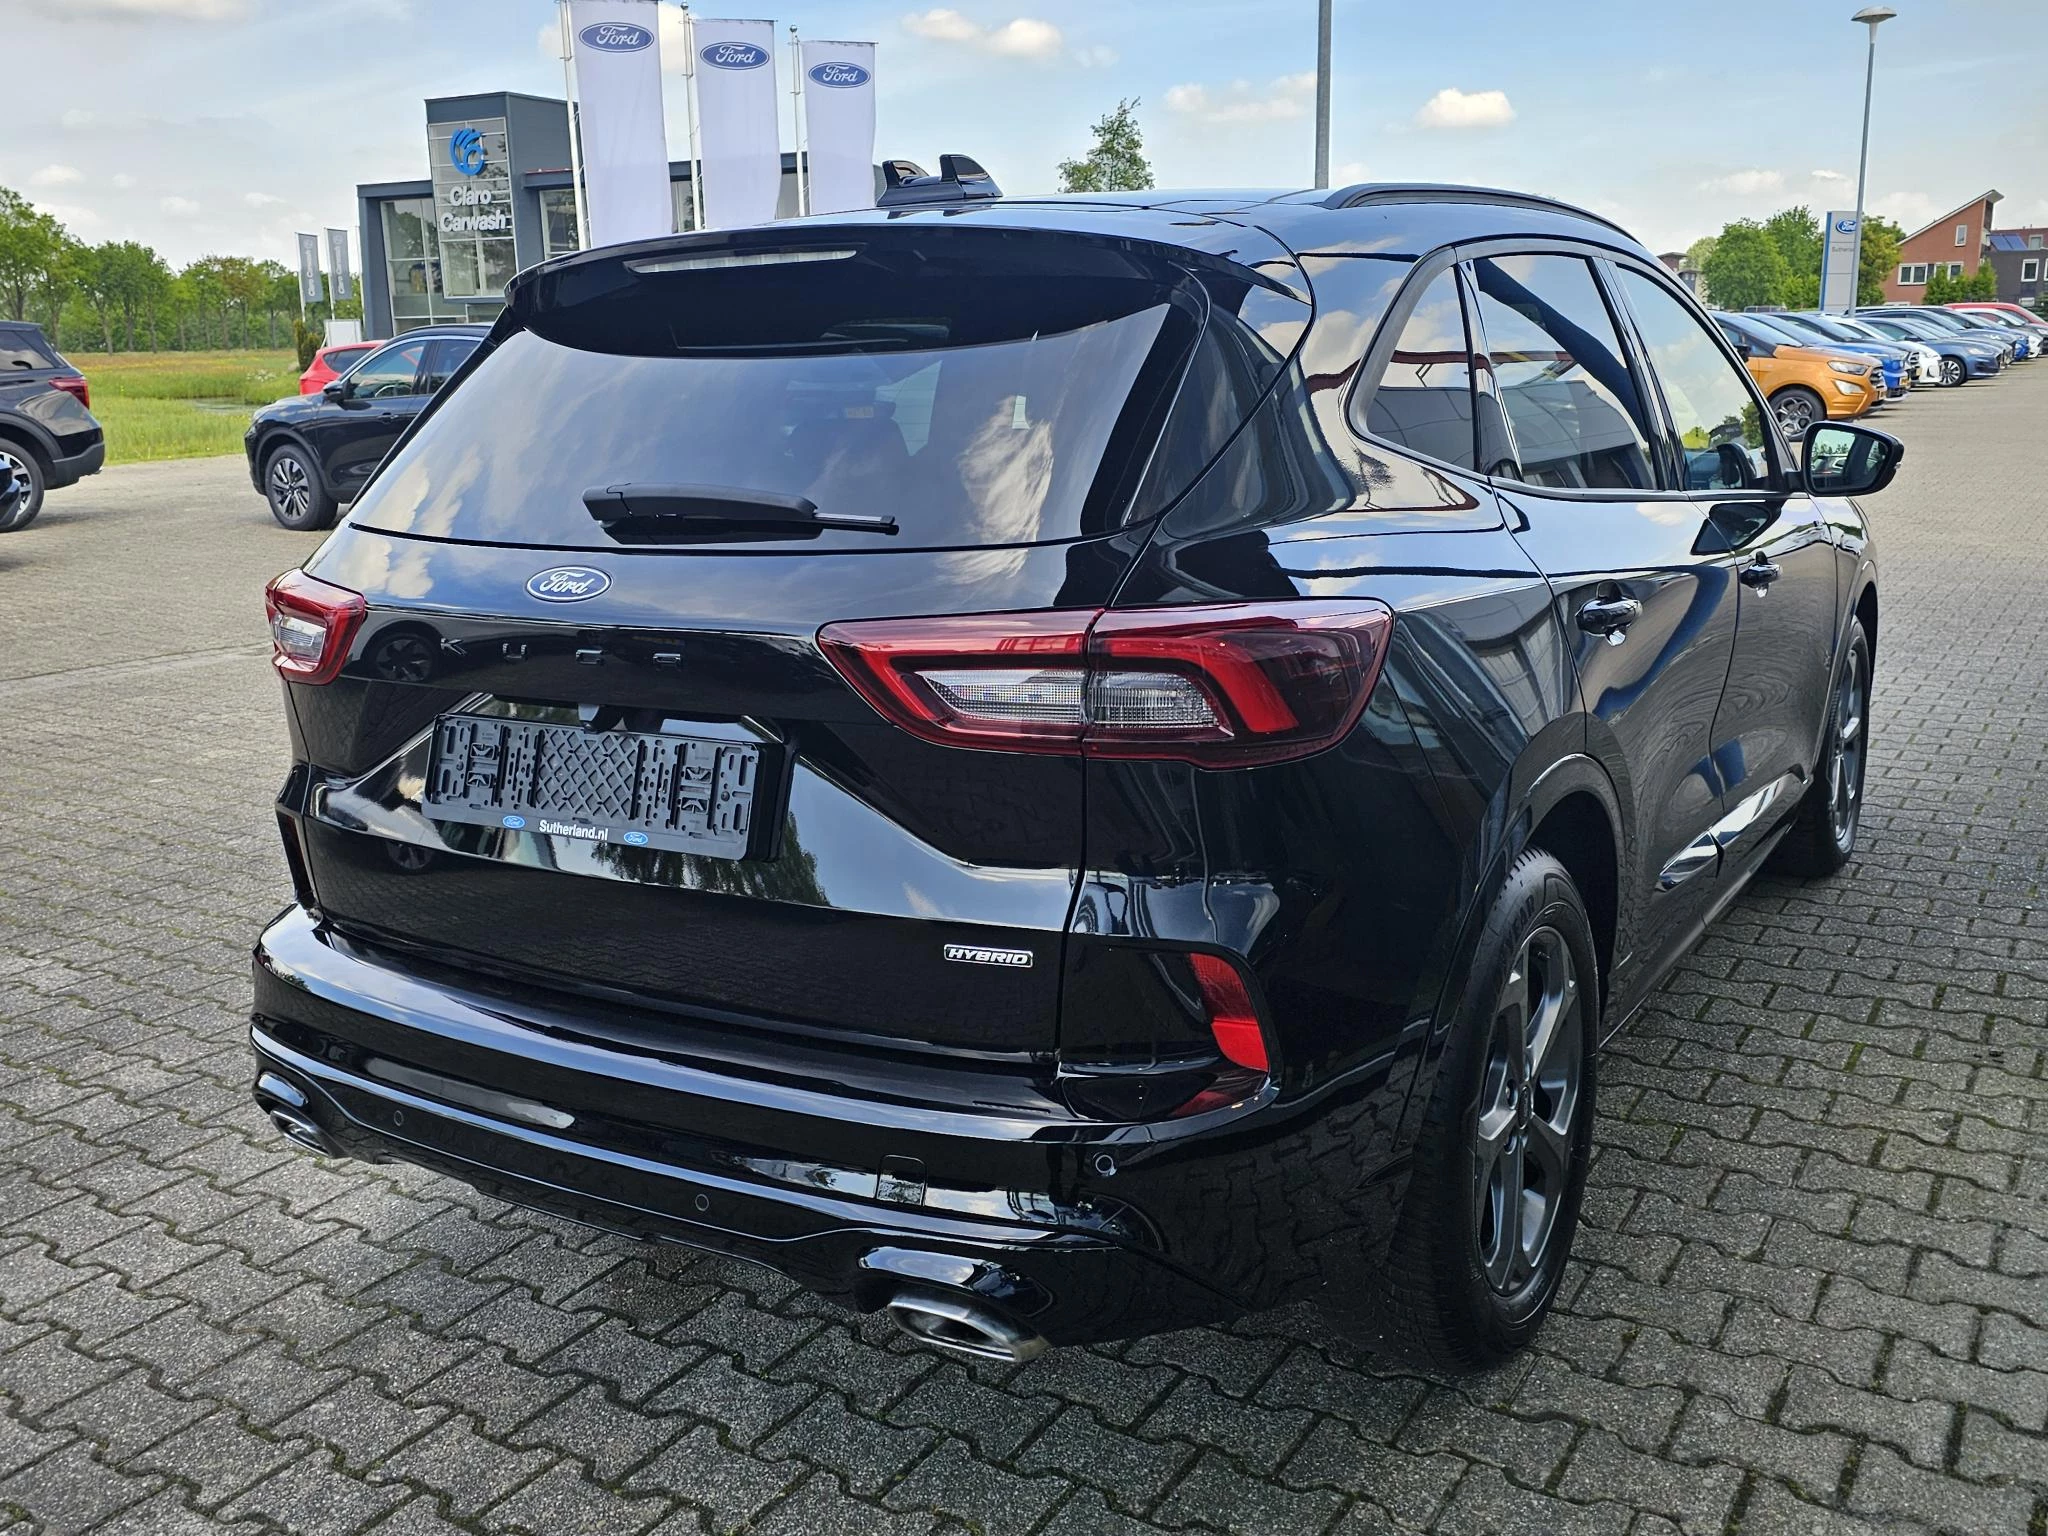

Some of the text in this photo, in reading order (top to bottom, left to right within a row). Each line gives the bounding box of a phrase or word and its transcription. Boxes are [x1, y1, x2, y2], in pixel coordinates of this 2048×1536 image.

[596, 24, 640, 46] Ford
[715, 44, 756, 64] Ford
[822, 64, 858, 83] Ford
[449, 185, 492, 207] Claro
[440, 209, 507, 232] Carwash
[540, 570, 595, 594] Ford
[539, 819, 609, 841] Sutherland.nl
[948, 948, 1028, 965] HYBRID
